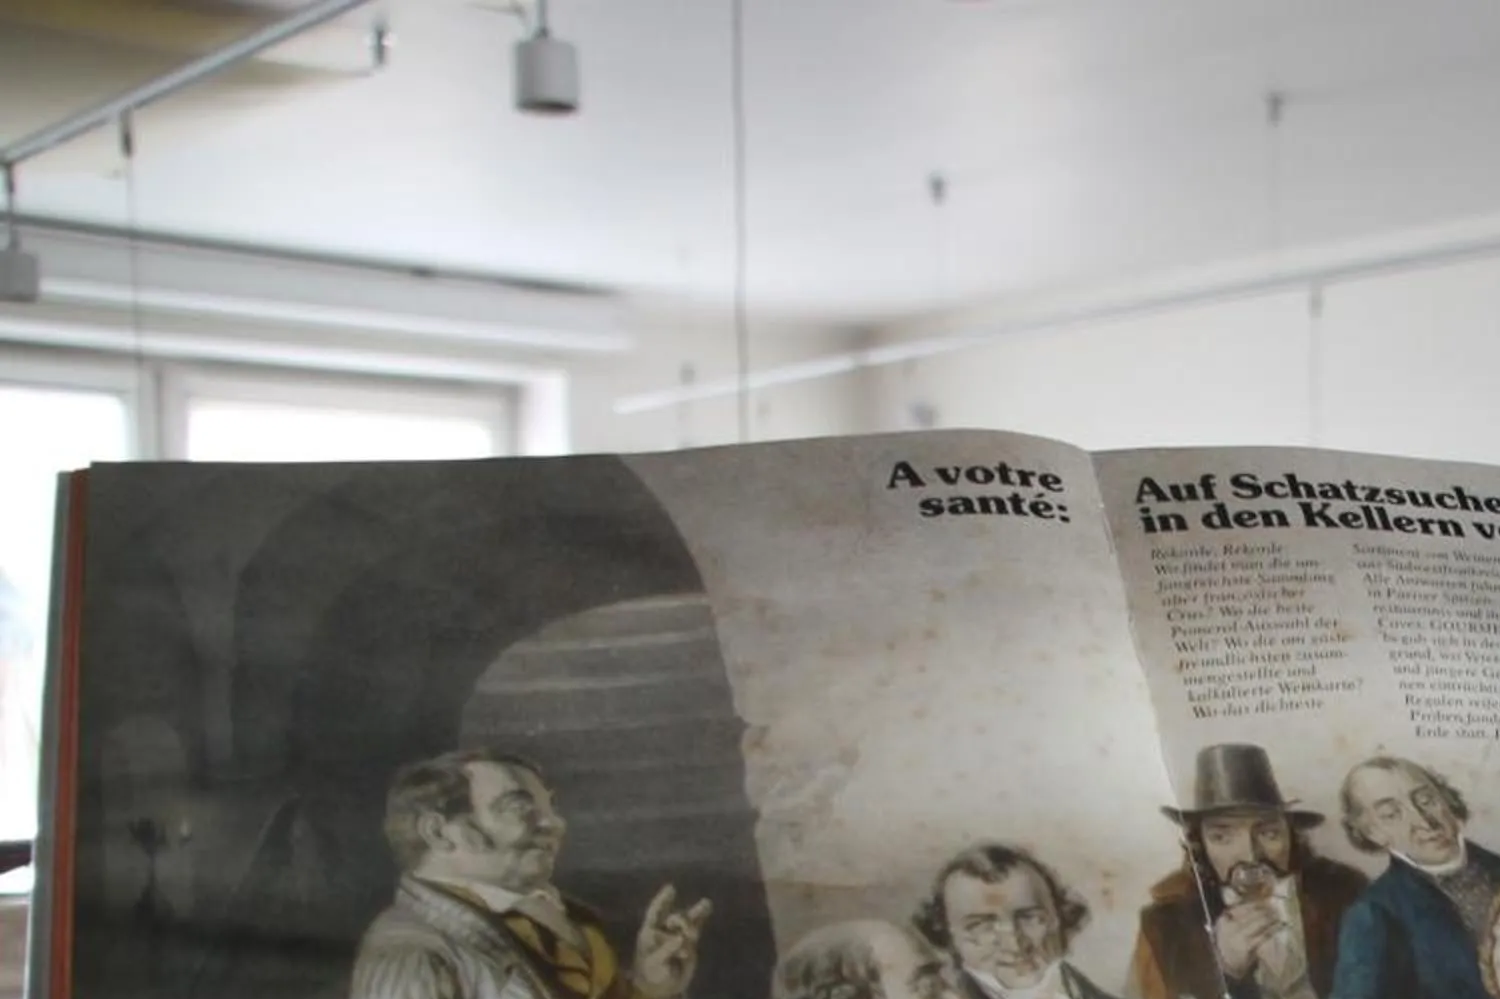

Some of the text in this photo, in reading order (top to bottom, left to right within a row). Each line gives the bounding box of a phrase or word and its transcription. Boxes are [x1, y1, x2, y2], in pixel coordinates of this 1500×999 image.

[887, 460, 1064, 492] A votre
[1136, 473, 1217, 503] Auf
[918, 492, 1071, 523] santé:
[1140, 506, 1189, 533] in
[1201, 501, 1291, 530] den
[1297, 502, 1465, 537] Kellern
